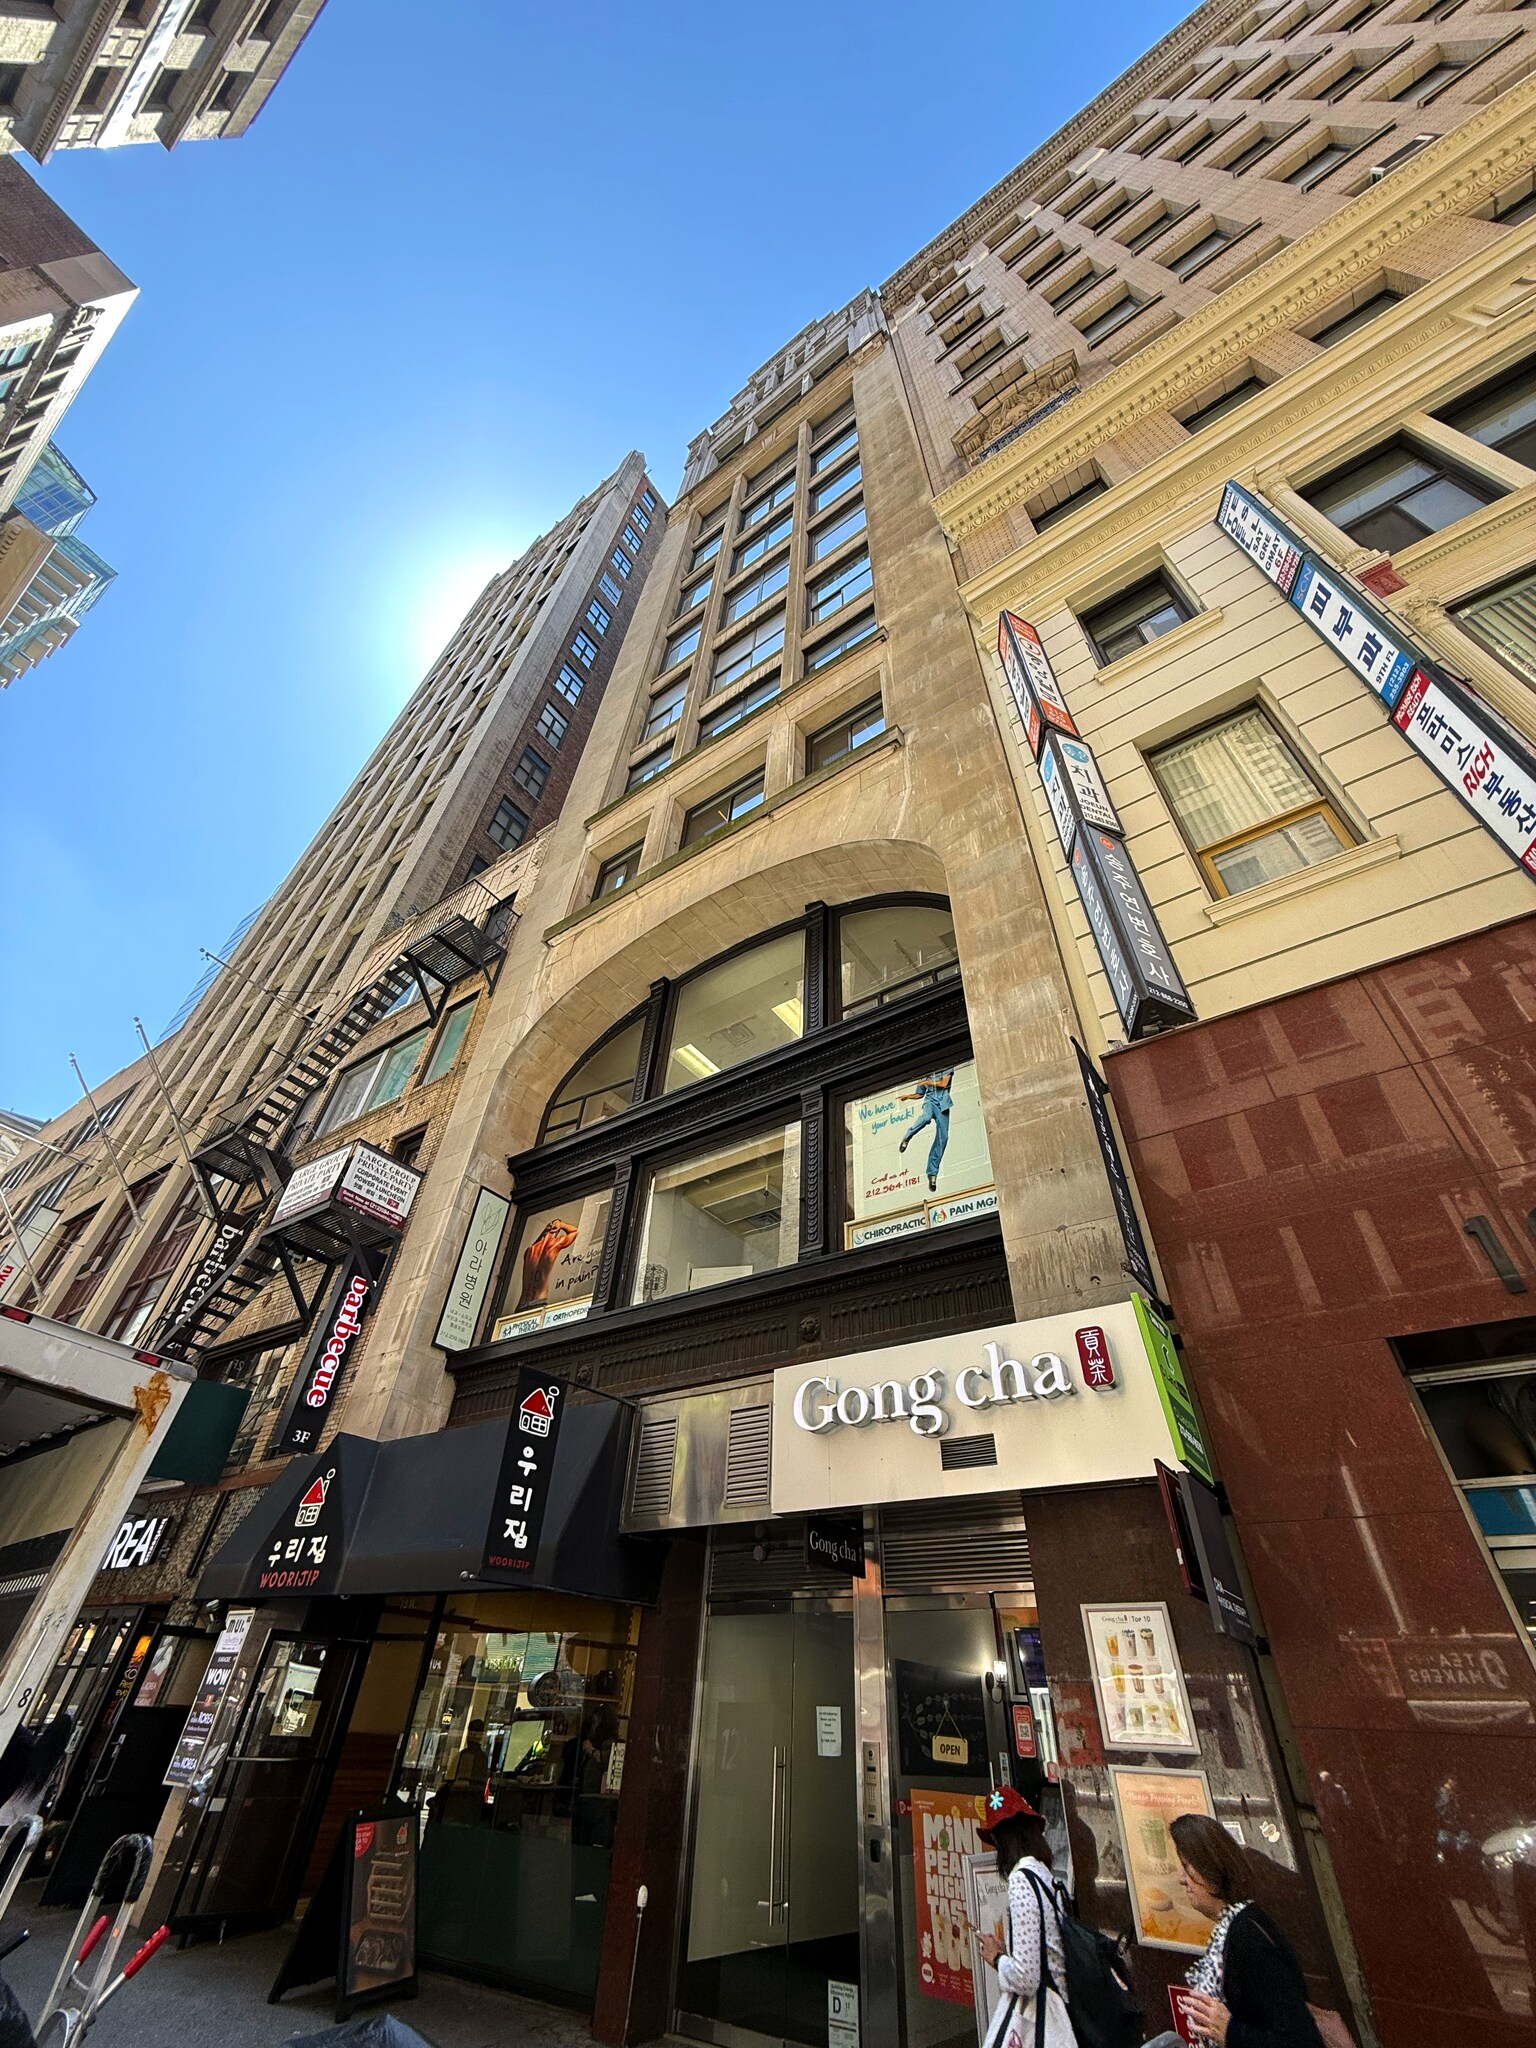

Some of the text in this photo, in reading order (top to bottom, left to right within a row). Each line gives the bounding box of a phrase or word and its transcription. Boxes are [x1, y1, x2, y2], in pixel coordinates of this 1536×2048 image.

[1252, 527, 1264, 553] SAT
[1259, 533, 1272, 561] GRE
[1265, 533, 1282, 571] GMAT
[1274, 548, 1285, 568] 6F
[1310, 581, 1384, 673] 피부과
[1376, 650, 1396, 684] 9TH FL
[1388, 665, 1402, 688] (212)
[1390, 662, 1411, 700] 255-3903
[1406, 688, 1424, 720] REALTY
[1415, 702, 1536, 835] 프라미스 RICH 부동산
[1070, 764, 1101, 804] 치과
[1080, 798, 1109, 812] JOEUN
[1080, 805, 1115, 820] DENTAL
[1104, 852, 1170, 987] 송주연변호사
[859, 1100, 896, 1120] We have
[871, 1107, 915, 1135] your back!
[357, 1158, 414, 1191] PRIVATE PARTY
[360, 1149, 417, 1184] LARGE GROUP
[354, 1174, 377, 1189] POWER
[375, 1181, 406, 1204] LUNCHEON
[356, 1167, 390, 1188] CORPORATE
[389, 1182, 409, 1197] EVENT
[949, 1202, 974, 1217] PAIN
[864, 1216, 926, 1240] CHIROPRACTIC
[561, 1253, 584, 1267] Are
[1465, 1208, 1536, 1294] 1
[458, 1238, 488, 1310] 아라병원
[555, 1265, 600, 1290] in pain?
[306, 1275, 369, 1408] barbecue
[793, 1340, 1074, 1436] Gong cha
[292, 1429, 311, 1445] 3F
[502, 1445, 538, 1550] 우리집
[102, 1517, 158, 1570] REA
[267, 1534, 328, 1568] 우리집
[809, 1530, 857, 1562] Gong cha
[488, 1555, 530, 1570] WOORIJIP
[259, 1569, 320, 1588] WOORIJIP
[1143, 1615, 1151, 1623] 10
[205, 1668, 232, 1686] WOW
[18, 1688, 32, 1708] 8
[939, 1743, 961, 1756] OPEN
[925, 1848, 962, 1878] PEA
[926, 1873, 966, 1901] MIGH
[832, 1995, 842, 2014] D
